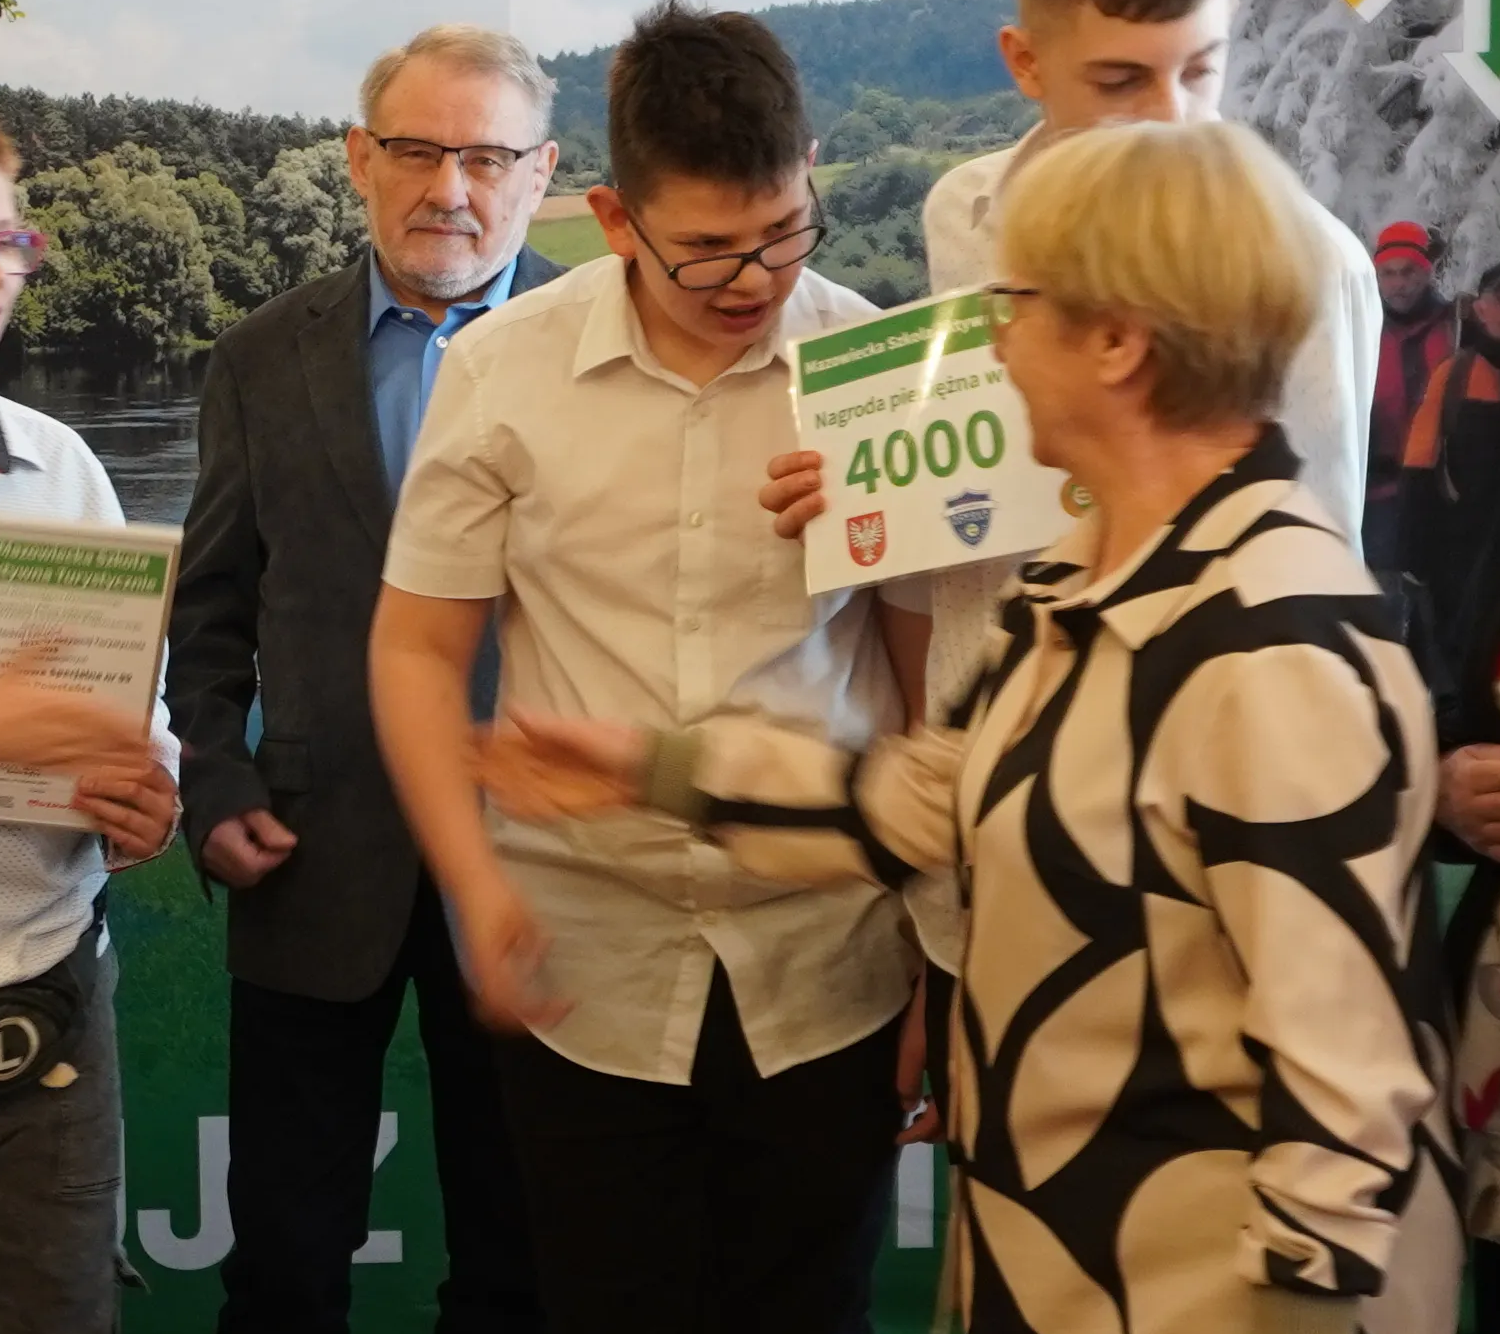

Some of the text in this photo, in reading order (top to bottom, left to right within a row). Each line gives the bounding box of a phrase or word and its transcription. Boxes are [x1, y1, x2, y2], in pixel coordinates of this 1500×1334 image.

[815, 397, 885, 429] Nagroda
[890, 375, 980, 412] pieężna
[846, 410, 1005, 494] 4000
